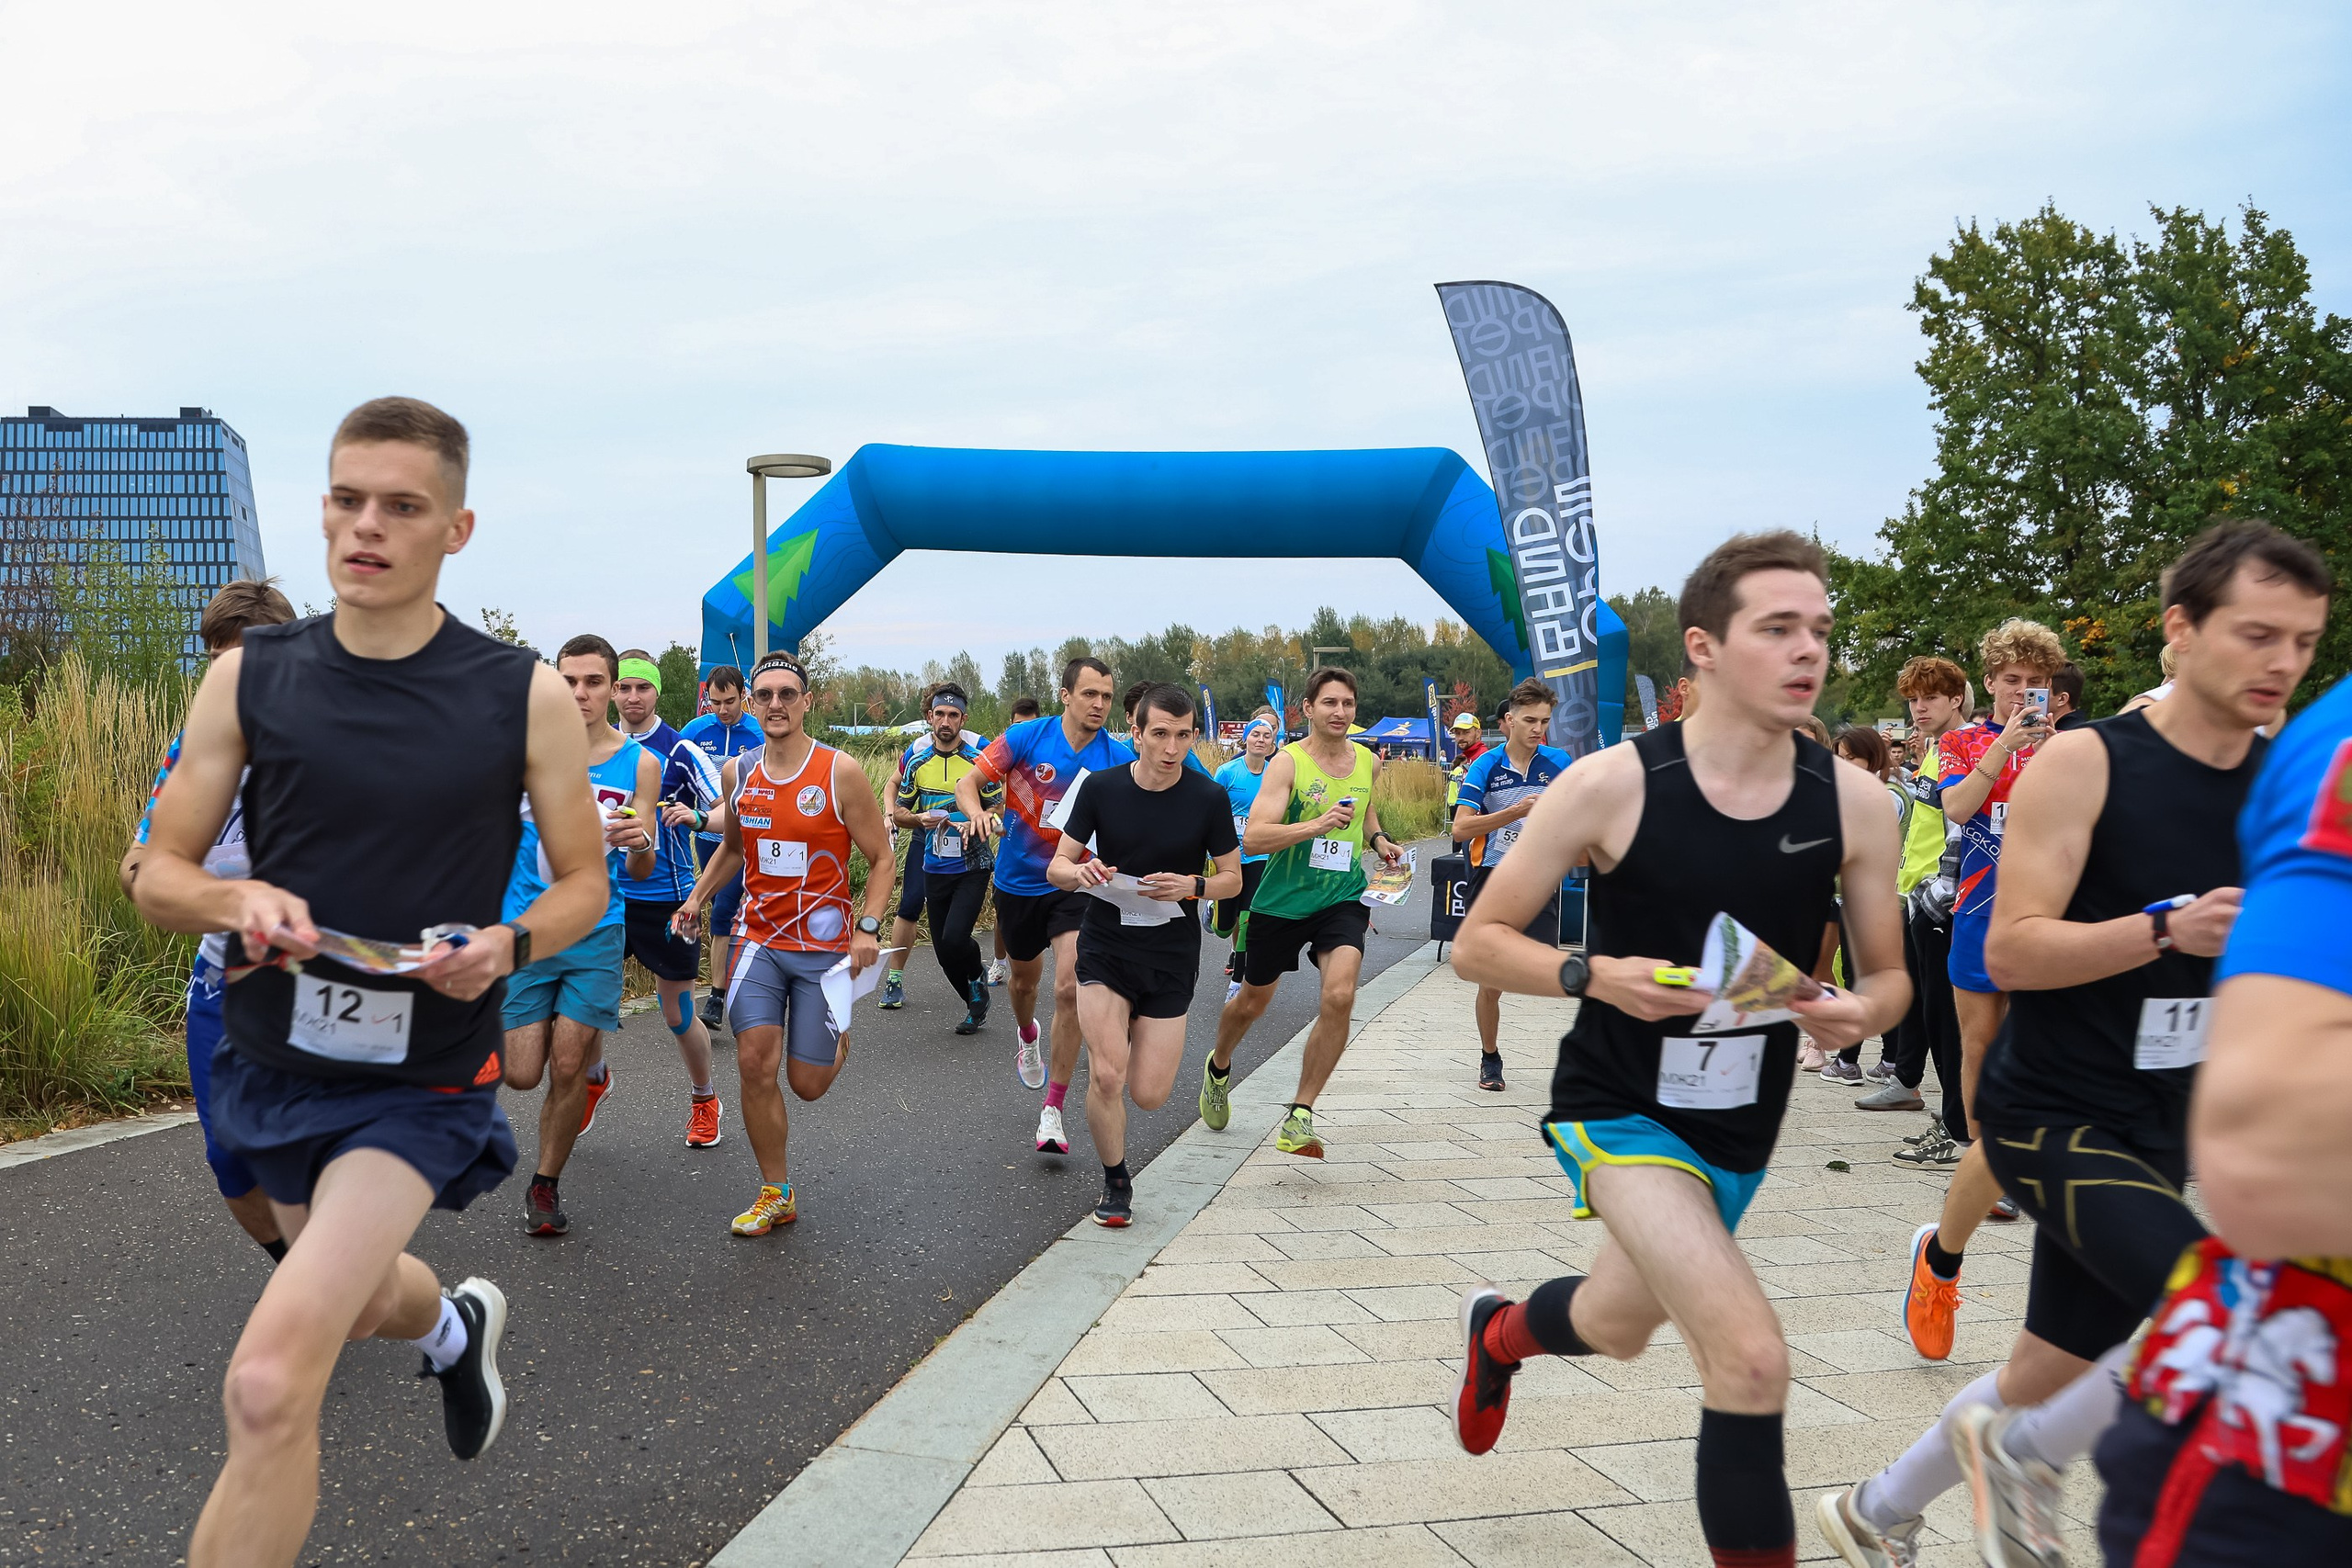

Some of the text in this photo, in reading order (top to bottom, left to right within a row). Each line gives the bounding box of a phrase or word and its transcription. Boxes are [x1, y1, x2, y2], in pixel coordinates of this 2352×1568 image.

[1494, 773, 1508, 782] read
[1500, 778, 1514, 786] map
[741, 816, 771, 826] FISHIAN
[1503, 830, 1519, 842] 53
[771, 841, 781, 858] 8
[1322, 840, 1339, 855] 18
[1347, 849, 1351, 858] 1
[799, 851, 804, 862] 1
[316, 984, 363, 1023] 12
[392, 1011, 403, 1033] 1
[2165, 1001, 2201, 1032] 11
[1698, 1041, 1718, 1072] 7
[1749, 1052, 1758, 1072] 1
